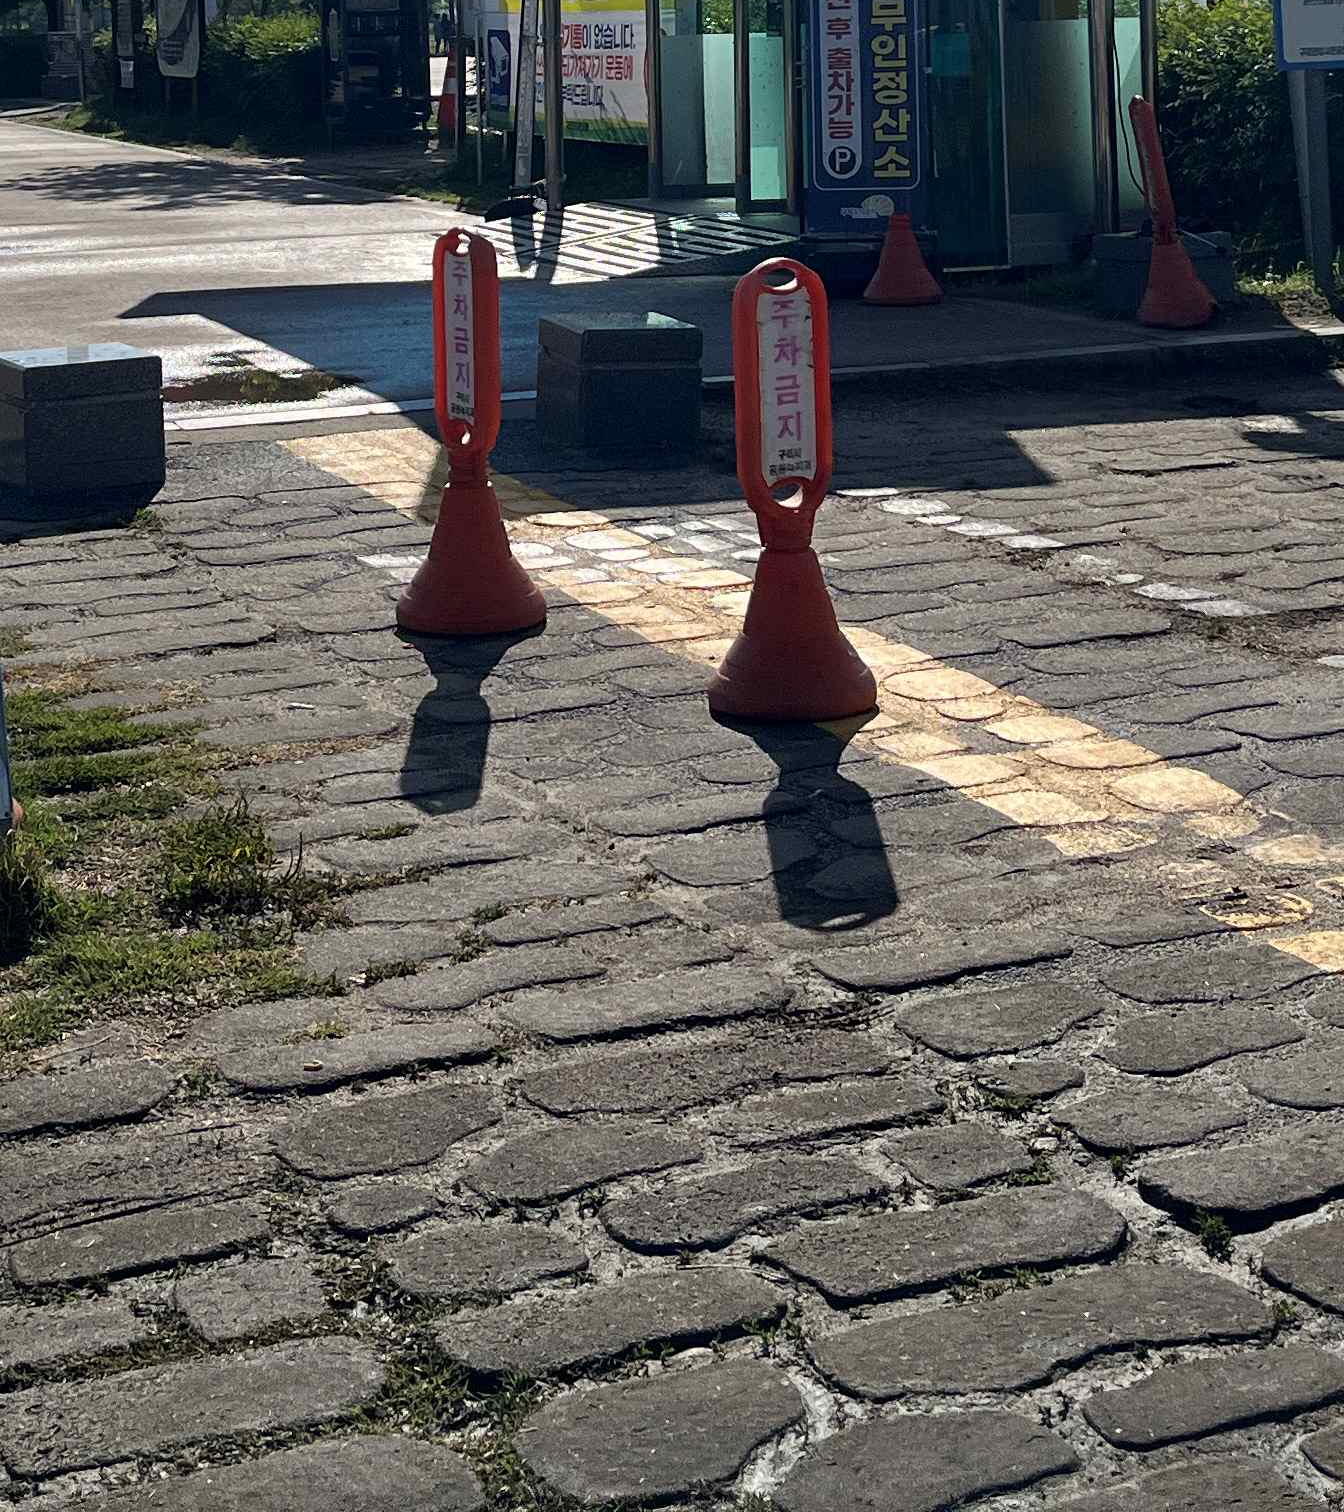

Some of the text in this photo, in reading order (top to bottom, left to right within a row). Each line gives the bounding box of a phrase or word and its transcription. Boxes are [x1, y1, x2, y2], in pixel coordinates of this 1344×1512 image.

[825, 16, 853, 40] 후
[826, 47, 855, 141] 출차가능
[451, 260, 473, 390] 주차금지
[771, 298, 804, 444] 주차금지
